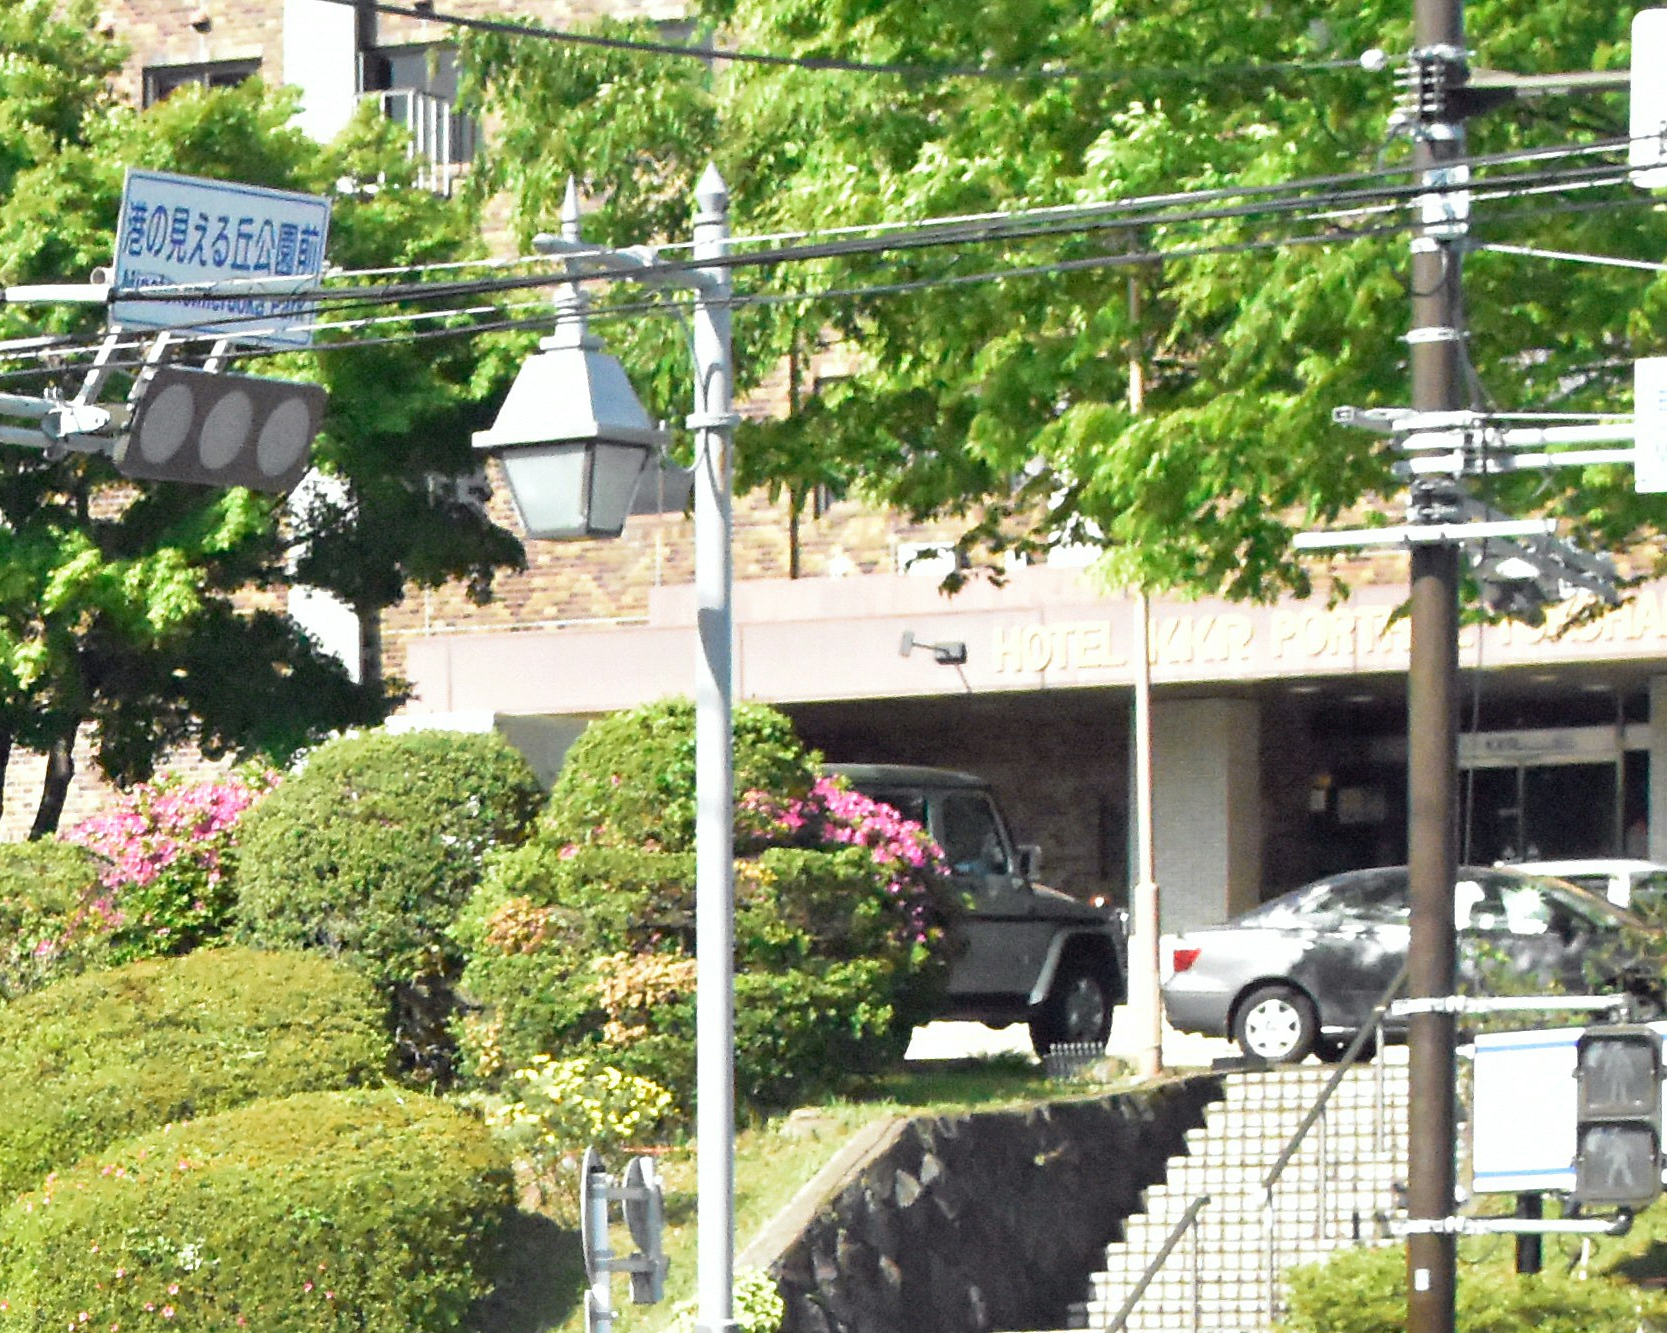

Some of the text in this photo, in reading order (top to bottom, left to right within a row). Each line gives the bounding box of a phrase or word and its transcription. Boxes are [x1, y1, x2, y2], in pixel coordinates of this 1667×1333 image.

[123, 201, 320, 276] 港の見える丘公園前
[991, 620, 1127, 672] HOTEL
[1148, 612, 1255, 665] KKR
[1270, 605, 1390, 659] PORT
